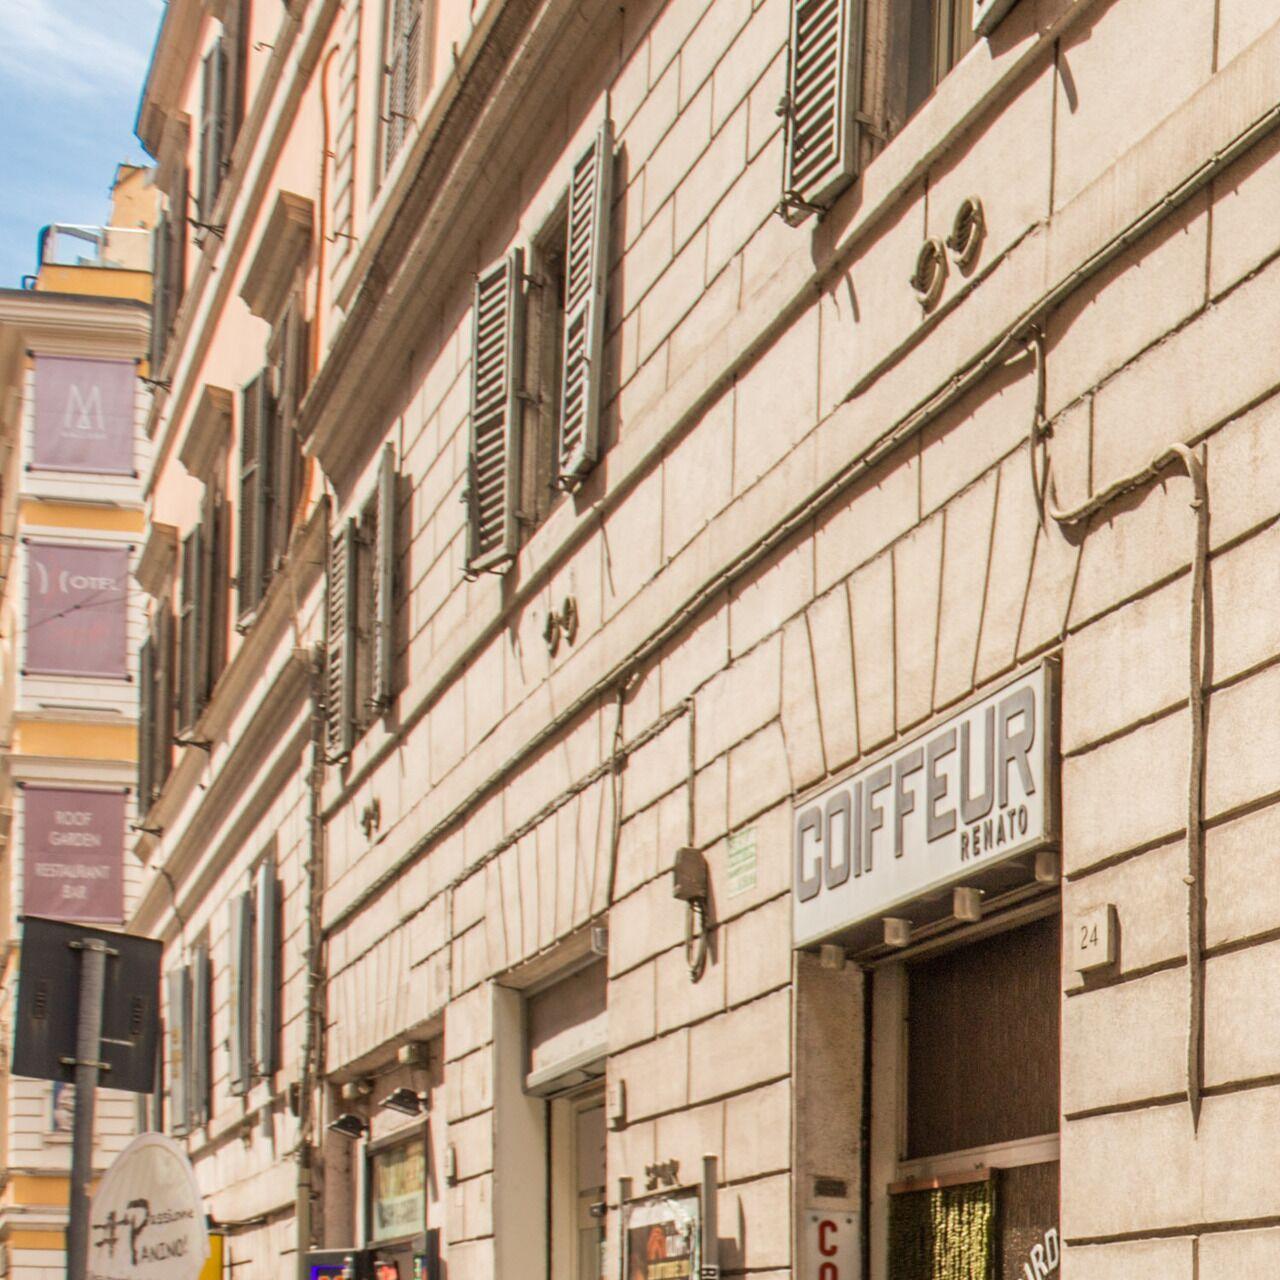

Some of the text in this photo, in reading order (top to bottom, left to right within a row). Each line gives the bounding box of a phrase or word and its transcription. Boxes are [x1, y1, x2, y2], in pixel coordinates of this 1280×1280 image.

[796, 685, 1036, 903] COIFFEUR
[55, 810, 93, 826] ROOF
[48, 831, 102, 847] GARDEN
[960, 804, 1029, 861] RENATO
[34, 862, 111, 879] RESTAURANT
[1081, 924, 1098, 949] 24
